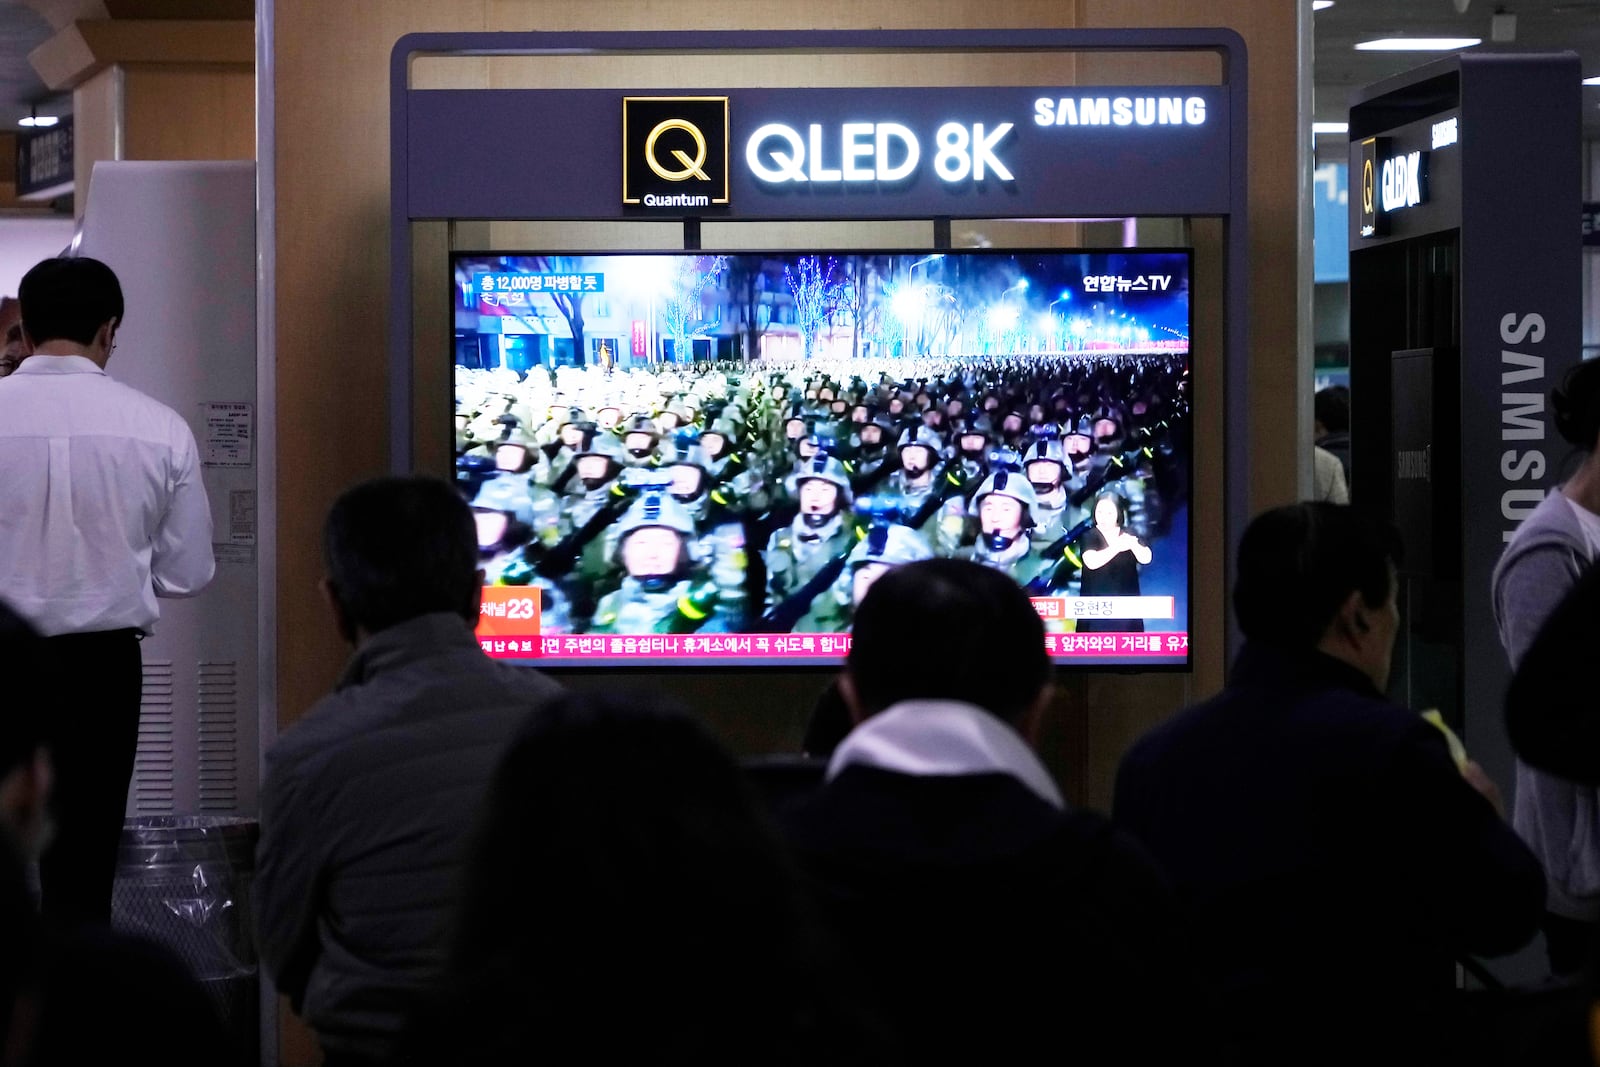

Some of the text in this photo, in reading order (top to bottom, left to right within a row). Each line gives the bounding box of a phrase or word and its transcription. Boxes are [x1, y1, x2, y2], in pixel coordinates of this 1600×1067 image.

[1034, 96, 1207, 126] SAMSUNG
[644, 118, 712, 182] Q
[745, 120, 1016, 184] QLED 8K
[643, 193, 709, 207] Quantum
[480, 275, 598, 292] 총 12,000명 파병할 듯
[1082, 275, 1172, 292] 연합뉴스TV
[480, 597, 534, 620] 채널 23
[1031, 601, 1113, 616] 편집 윤현정
[481, 640, 533, 653] 재난속보
[564, 637, 606, 653] 주변의
[610, 637, 679, 654] 졸음쉼터나
[682, 637, 751, 653] 휴게소에서
[755, 637, 769, 653] 꼭
[774, 637, 815, 653] 쉬도록
[1061, 636, 1117, 652] 앞차와의
[1121, 636, 1162, 652] 거리를
